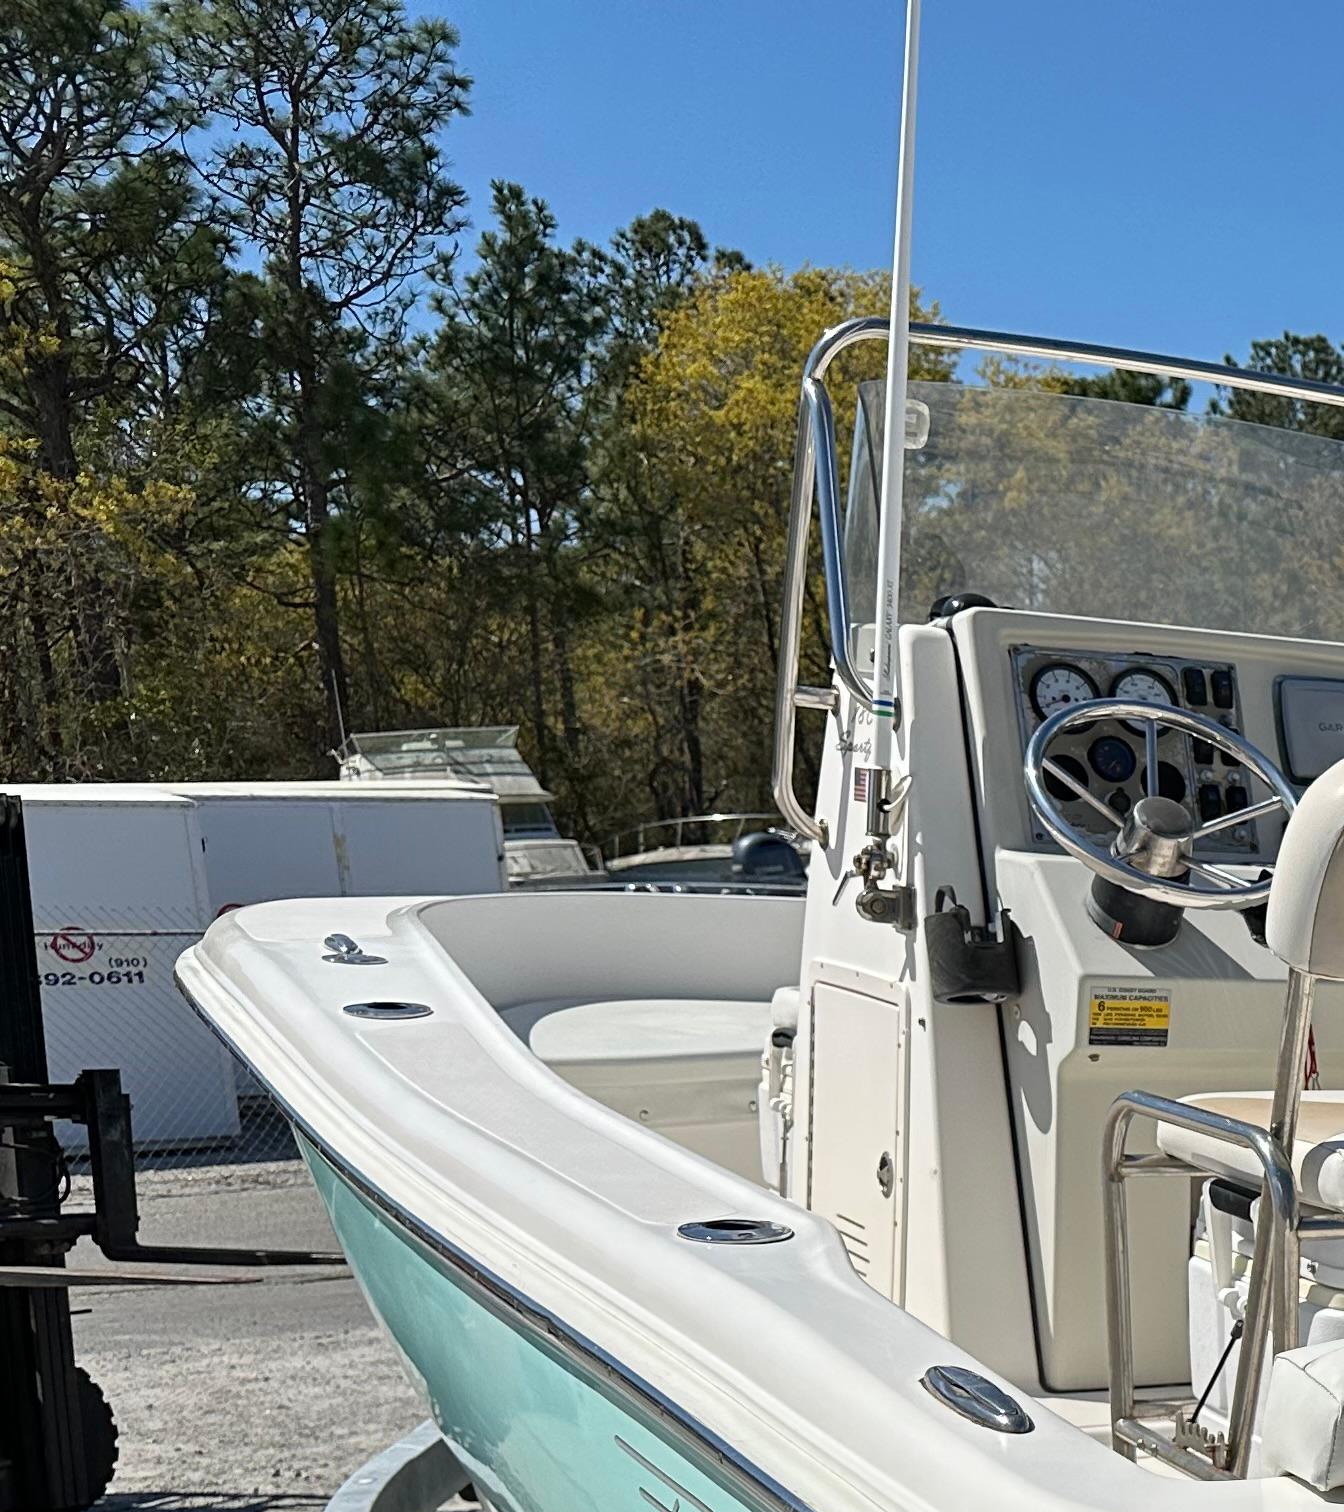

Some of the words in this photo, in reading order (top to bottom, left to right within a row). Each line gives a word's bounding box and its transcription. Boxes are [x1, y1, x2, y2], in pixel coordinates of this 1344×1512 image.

[108, 957, 148, 968] (910)
[39, 970, 145, 986] 92-0611
[1098, 1001, 1105, 1012] 6
